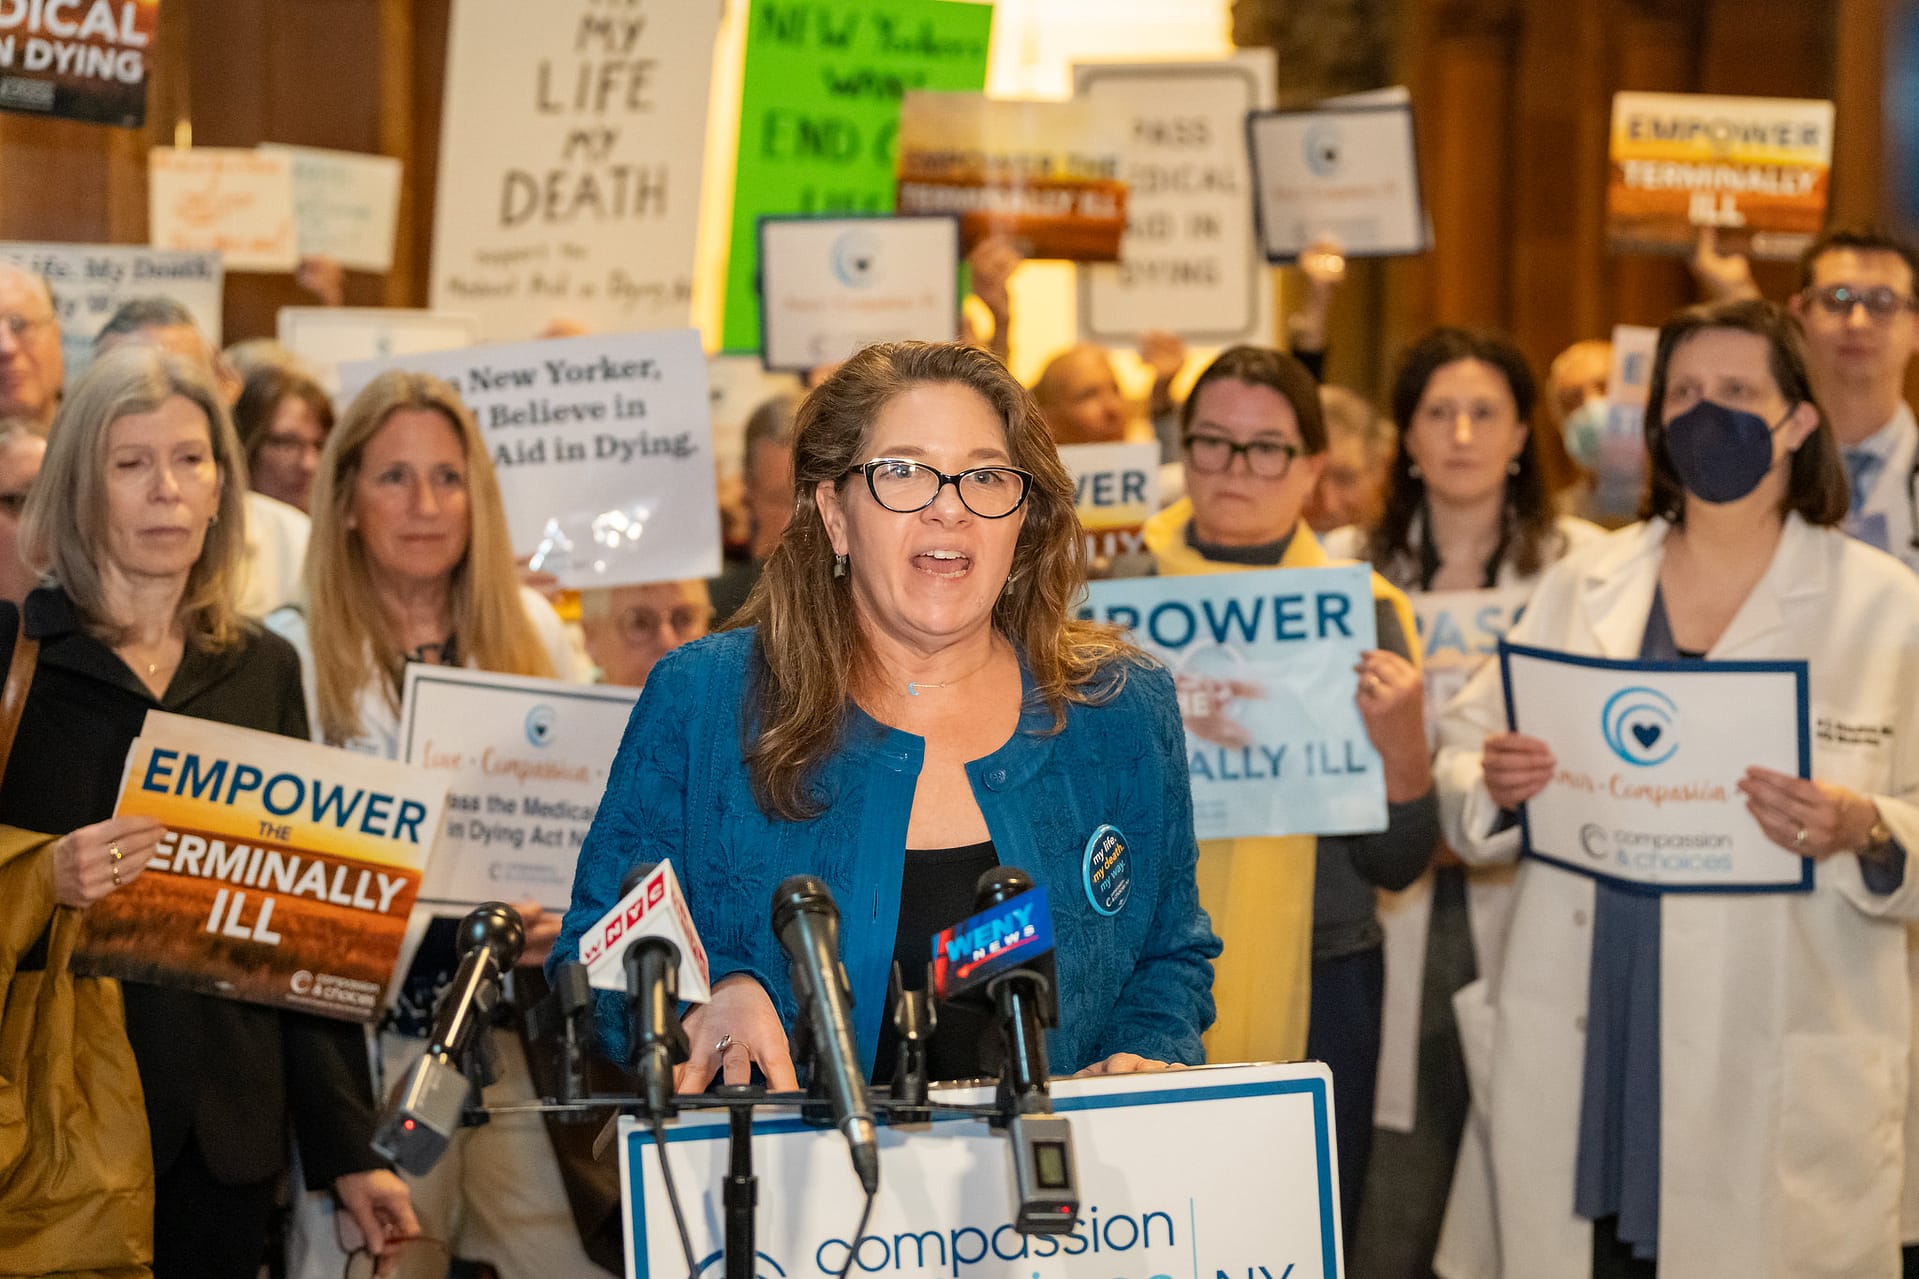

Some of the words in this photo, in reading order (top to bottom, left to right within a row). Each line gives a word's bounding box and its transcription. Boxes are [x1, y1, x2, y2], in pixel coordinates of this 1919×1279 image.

[574, 13, 647, 52] MY
[24, 37, 144, 84] DYING
[536, 57, 660, 116] LIFE
[762, 108, 862, 167] END
[1132, 117, 1212, 146] PASS
[1629, 114, 1818, 147] EMPOWER
[499, 163, 669, 228] DEATH
[1624, 158, 1816, 196] TERMINALLY
[1689, 190, 1746, 229] ILL
[468, 366, 537, 392] New
[543, 354, 663, 385] Yorker,
[488, 399, 607, 429] Believe
[614, 392, 646, 419] in
[494, 437, 546, 466] Aid
[555, 437, 586, 463] in
[594, 430, 698, 463] Dying.
[1077, 592, 1354, 649] POWER
[1305, 739, 1367, 777] ILL
[141, 747, 427, 844] EMPOWER
[486, 795, 517, 815] the
[258, 820, 293, 842] THE
[469, 818, 525, 849] Dying
[529, 825, 565, 847] Act
[1093, 849, 1104, 866] my
[1103, 836, 1117, 852] life.
[1093, 866, 1105, 883] my
[1104, 843, 1125, 870] death.
[145, 832, 409, 913] ERMINALLY
[1100, 876, 1111, 892] my
[1111, 859, 1126, 879] way.
[206, 888, 282, 946] ILL
[584, 872, 666, 960] WNYC
[946, 902, 1034, 961] WENY
[973, 924, 1035, 961] NEWS
[815, 1205, 1177, 1279] compassion
